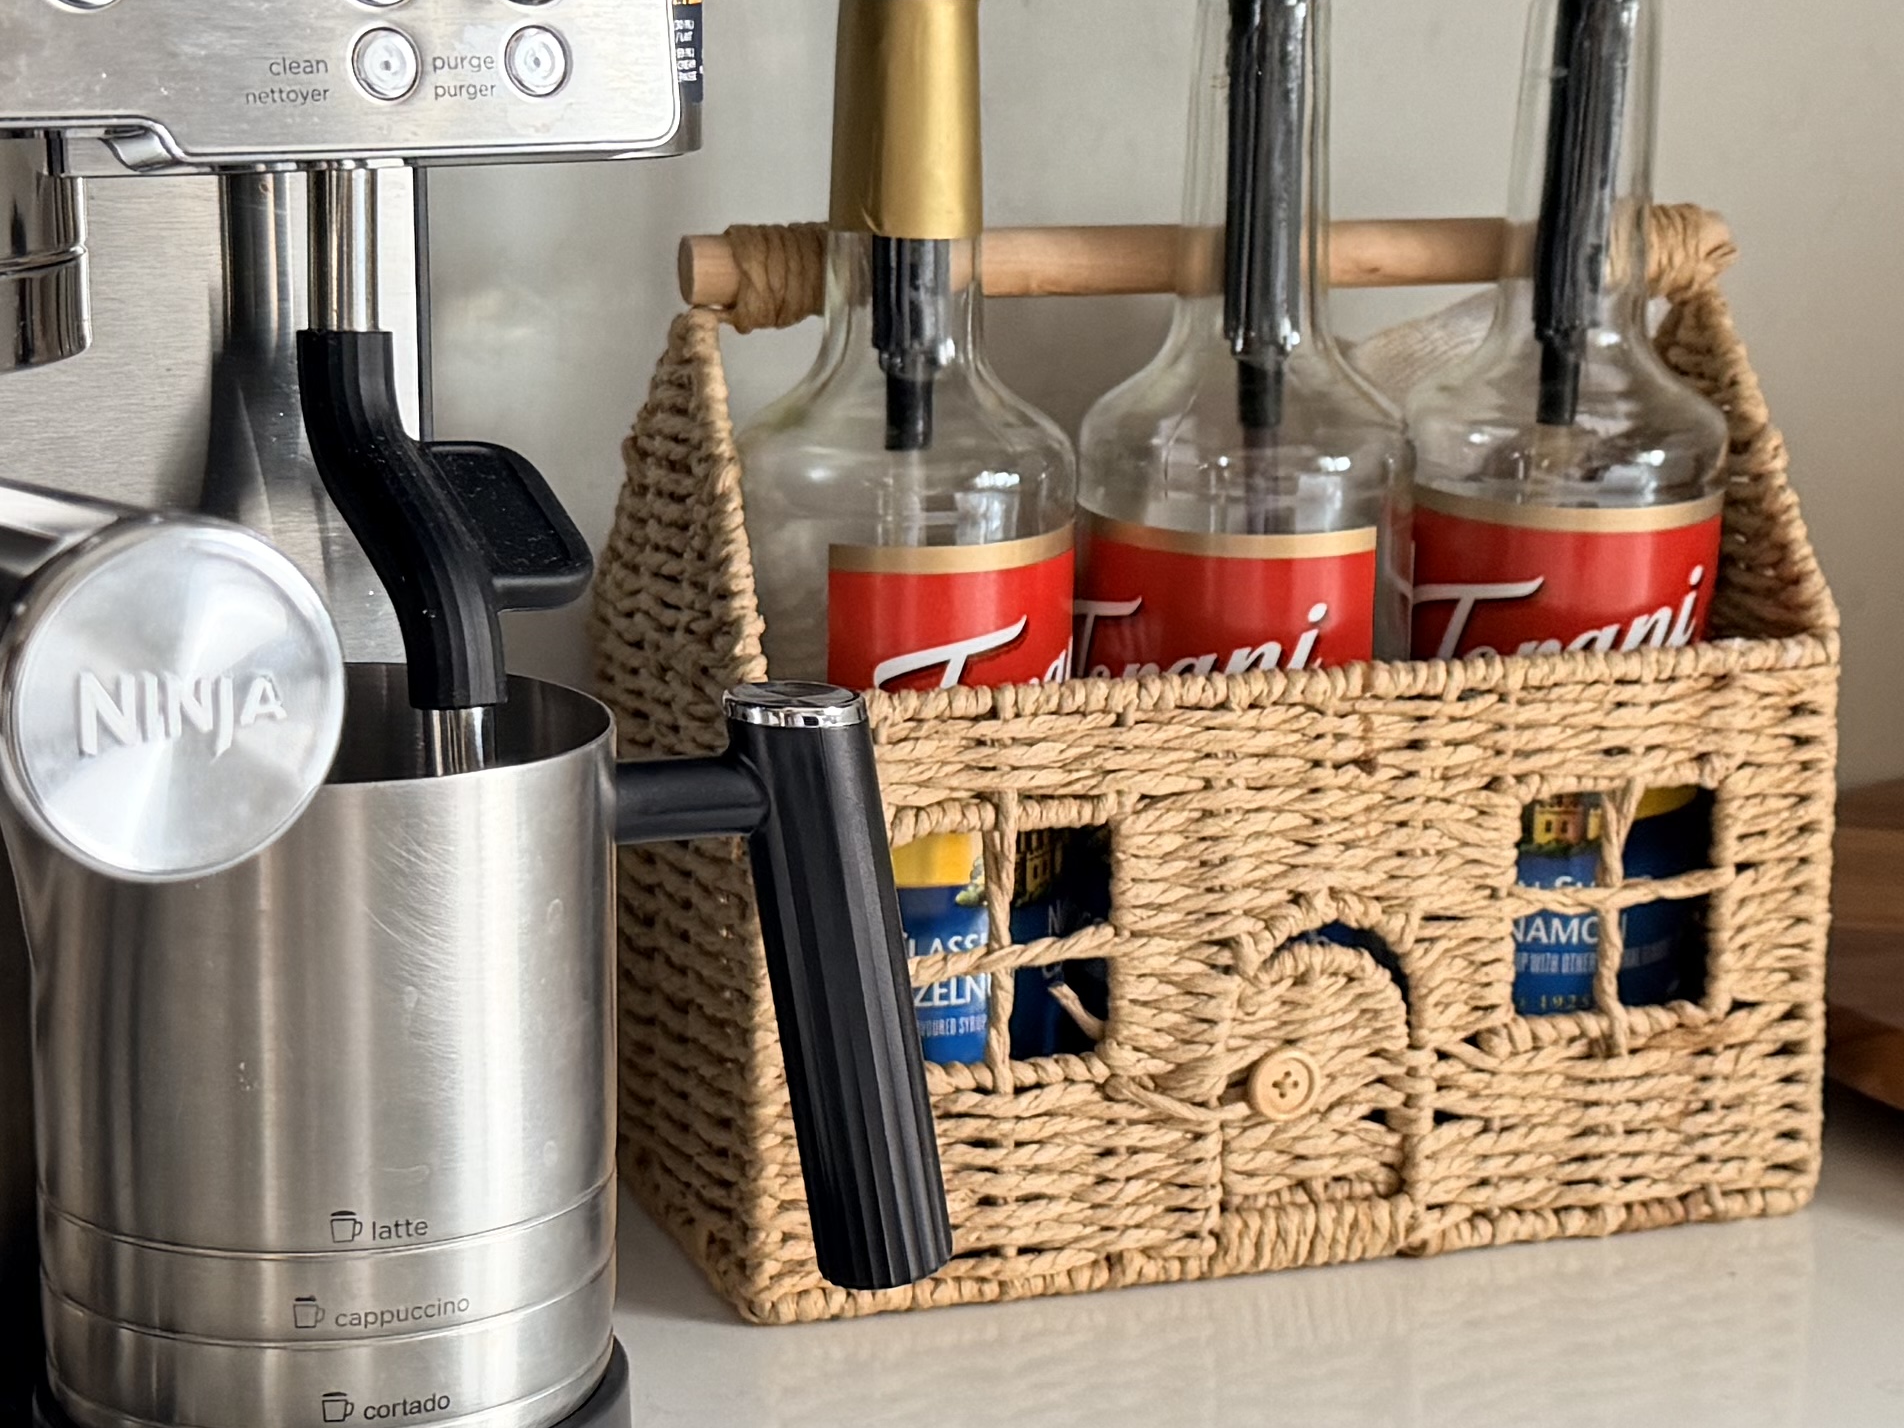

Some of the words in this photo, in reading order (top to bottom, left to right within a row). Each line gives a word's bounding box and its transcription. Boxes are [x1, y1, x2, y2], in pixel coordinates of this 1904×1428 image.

[269, 56, 328, 76] clean
[432, 53, 495, 74] purge
[245, 85, 329, 106] nettoyer
[434, 82, 496, 101] purger
[77, 670, 288, 765] NINJA
[371, 1217, 428, 1241] latte
[335, 1294, 470, 1330] cappuccino
[363, 1391, 450, 1421] cortado
